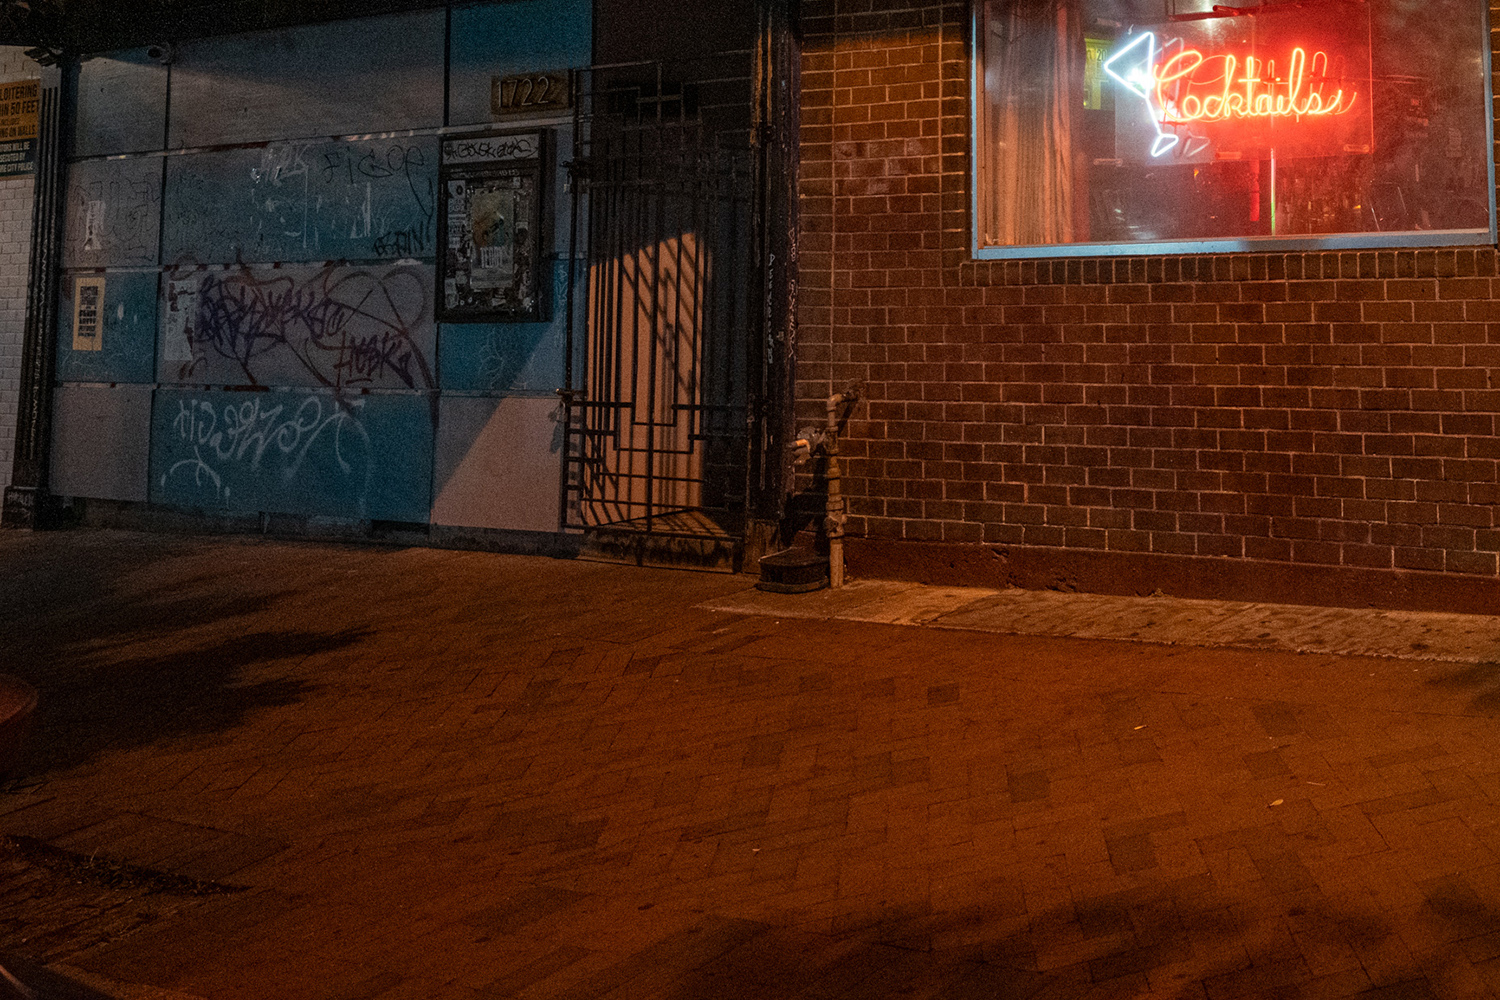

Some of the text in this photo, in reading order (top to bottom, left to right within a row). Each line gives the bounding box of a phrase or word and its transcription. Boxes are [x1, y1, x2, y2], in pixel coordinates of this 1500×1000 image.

[496, 75, 550, 109] 1722
[1153, 47, 1343, 121] Cocktails
[22, 99, 40, 114] FEET
